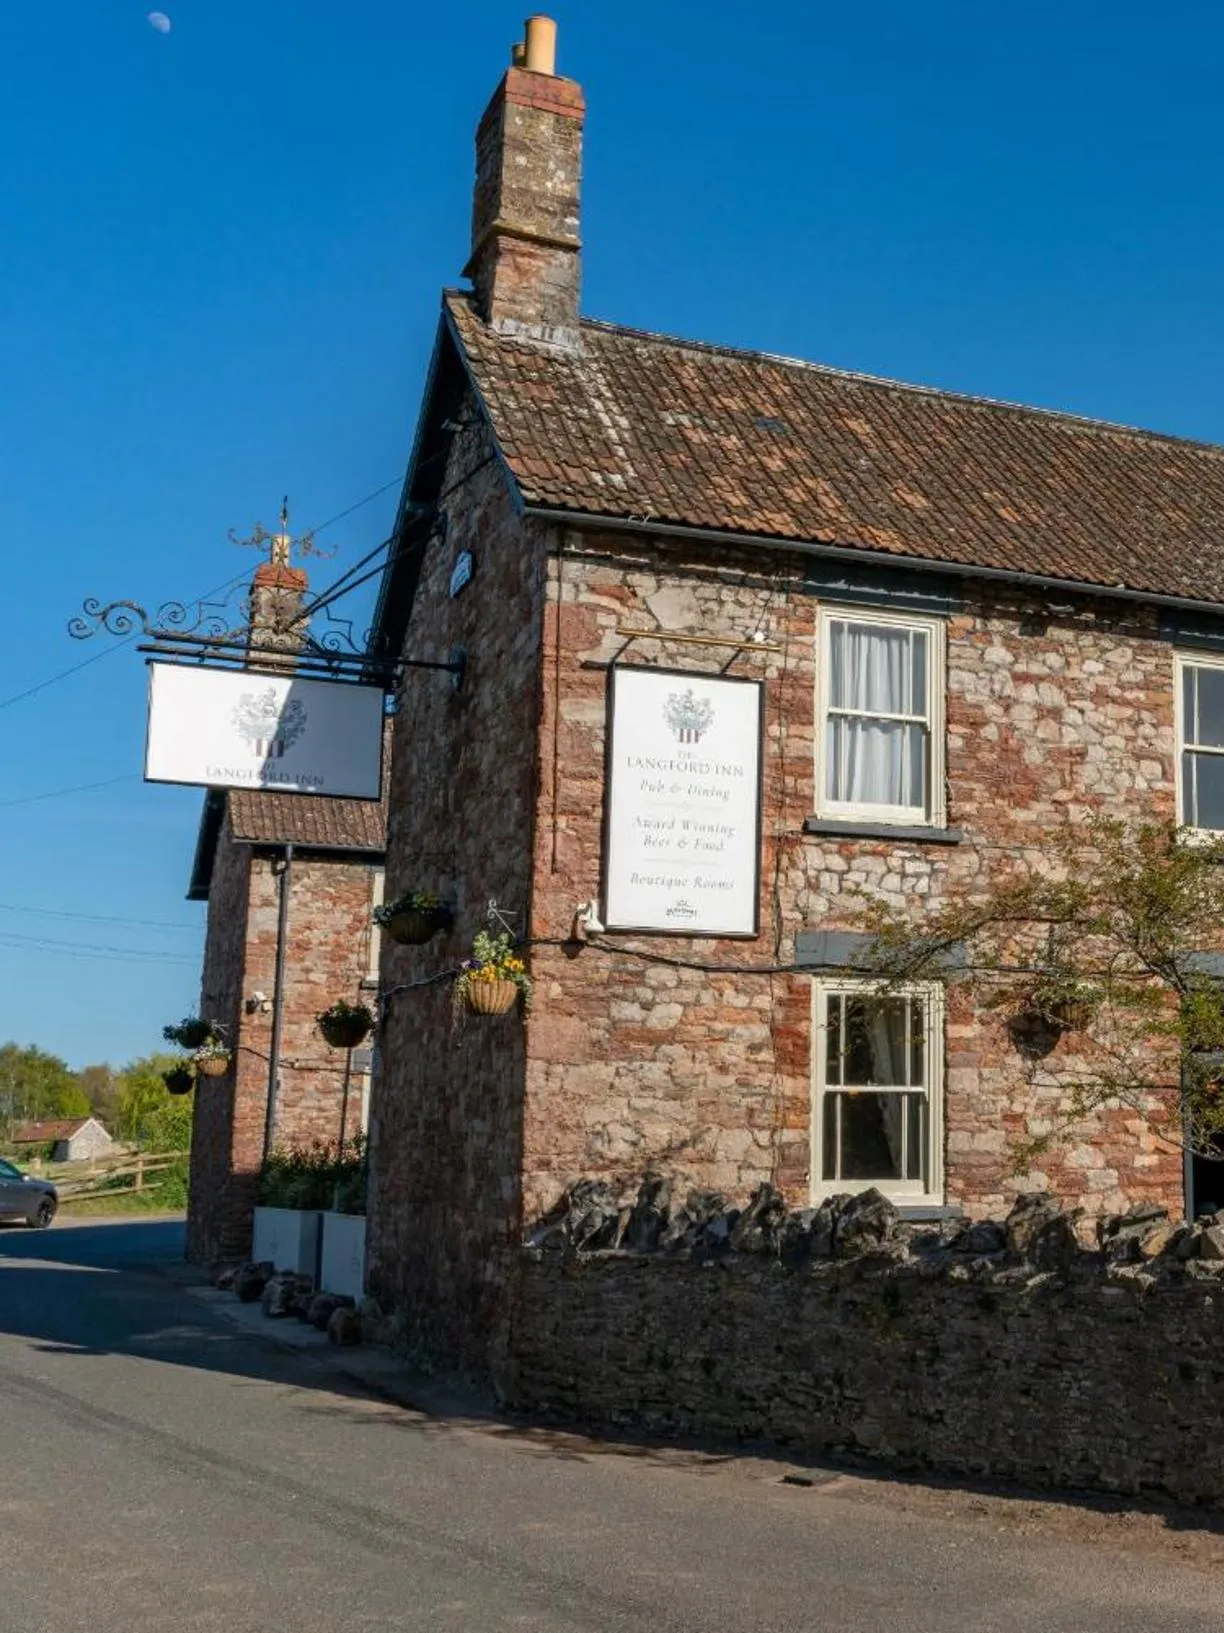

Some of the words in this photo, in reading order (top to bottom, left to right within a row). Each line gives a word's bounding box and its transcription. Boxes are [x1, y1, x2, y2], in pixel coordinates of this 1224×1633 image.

[206, 765, 290, 782] LANGFORD
[296, 773, 325, 786] INN
[627, 755, 710, 775] LANGFORD
[715, 764, 744, 777] INN
[641, 779, 665, 793] Pub
[669, 782, 682, 794] &
[687, 783, 731, 801] Dining
[632, 815, 676, 830] Award
[682, 819, 736, 838] Winning
[677, 837, 690, 849] &
[694, 837, 725, 851] Food
[630, 871, 687, 891] Boutique
[693, 875, 735, 890] Rooms
